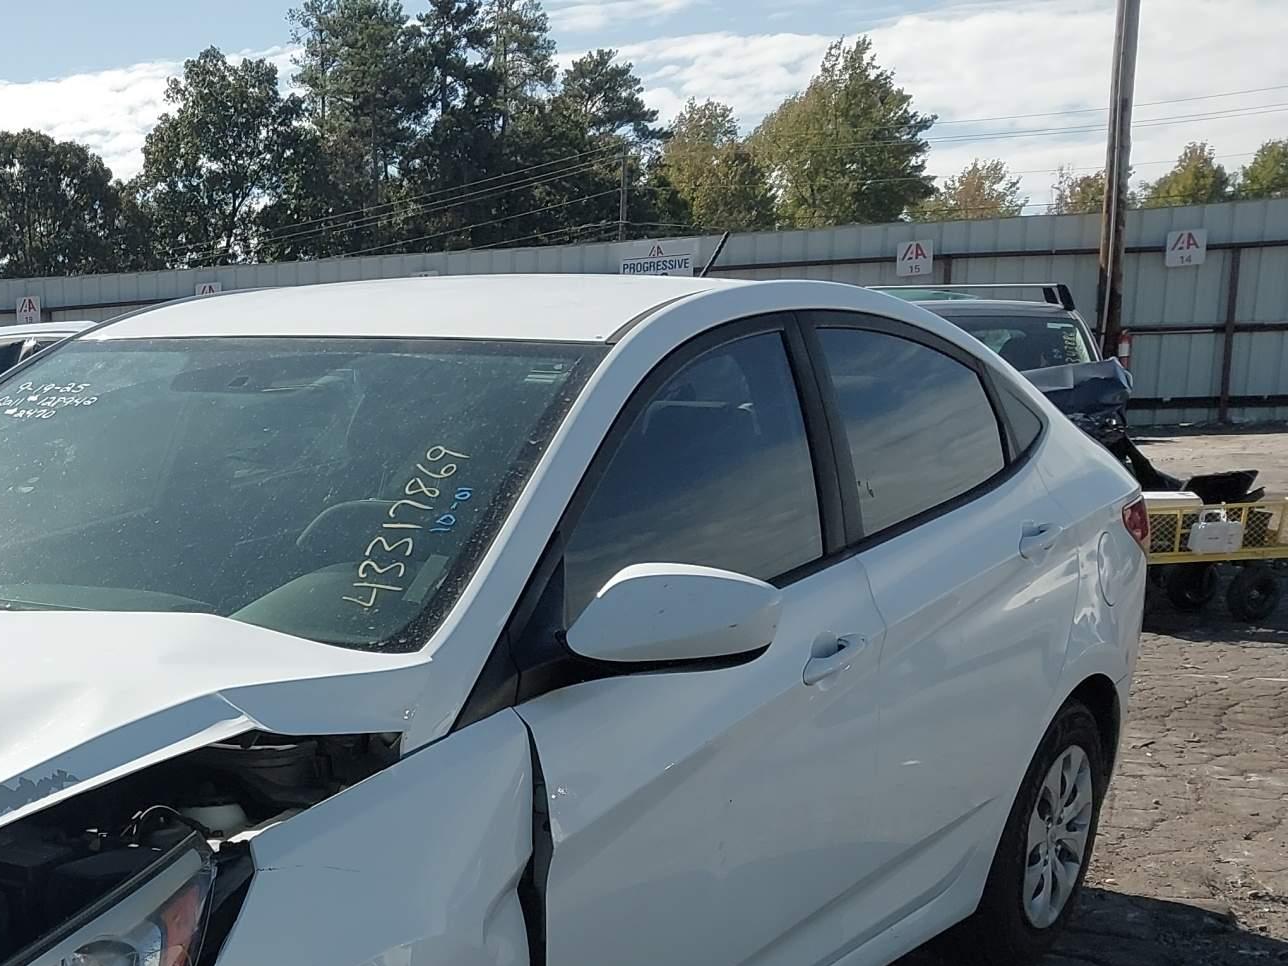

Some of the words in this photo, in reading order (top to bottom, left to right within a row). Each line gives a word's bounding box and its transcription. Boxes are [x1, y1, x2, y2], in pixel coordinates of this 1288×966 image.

[622, 258, 690, 274] PROGRESSIVE
[909, 264, 921, 273] 15
[16, 381, 91, 394] 9-19-25
[341, 445, 472, 608] 43317869
